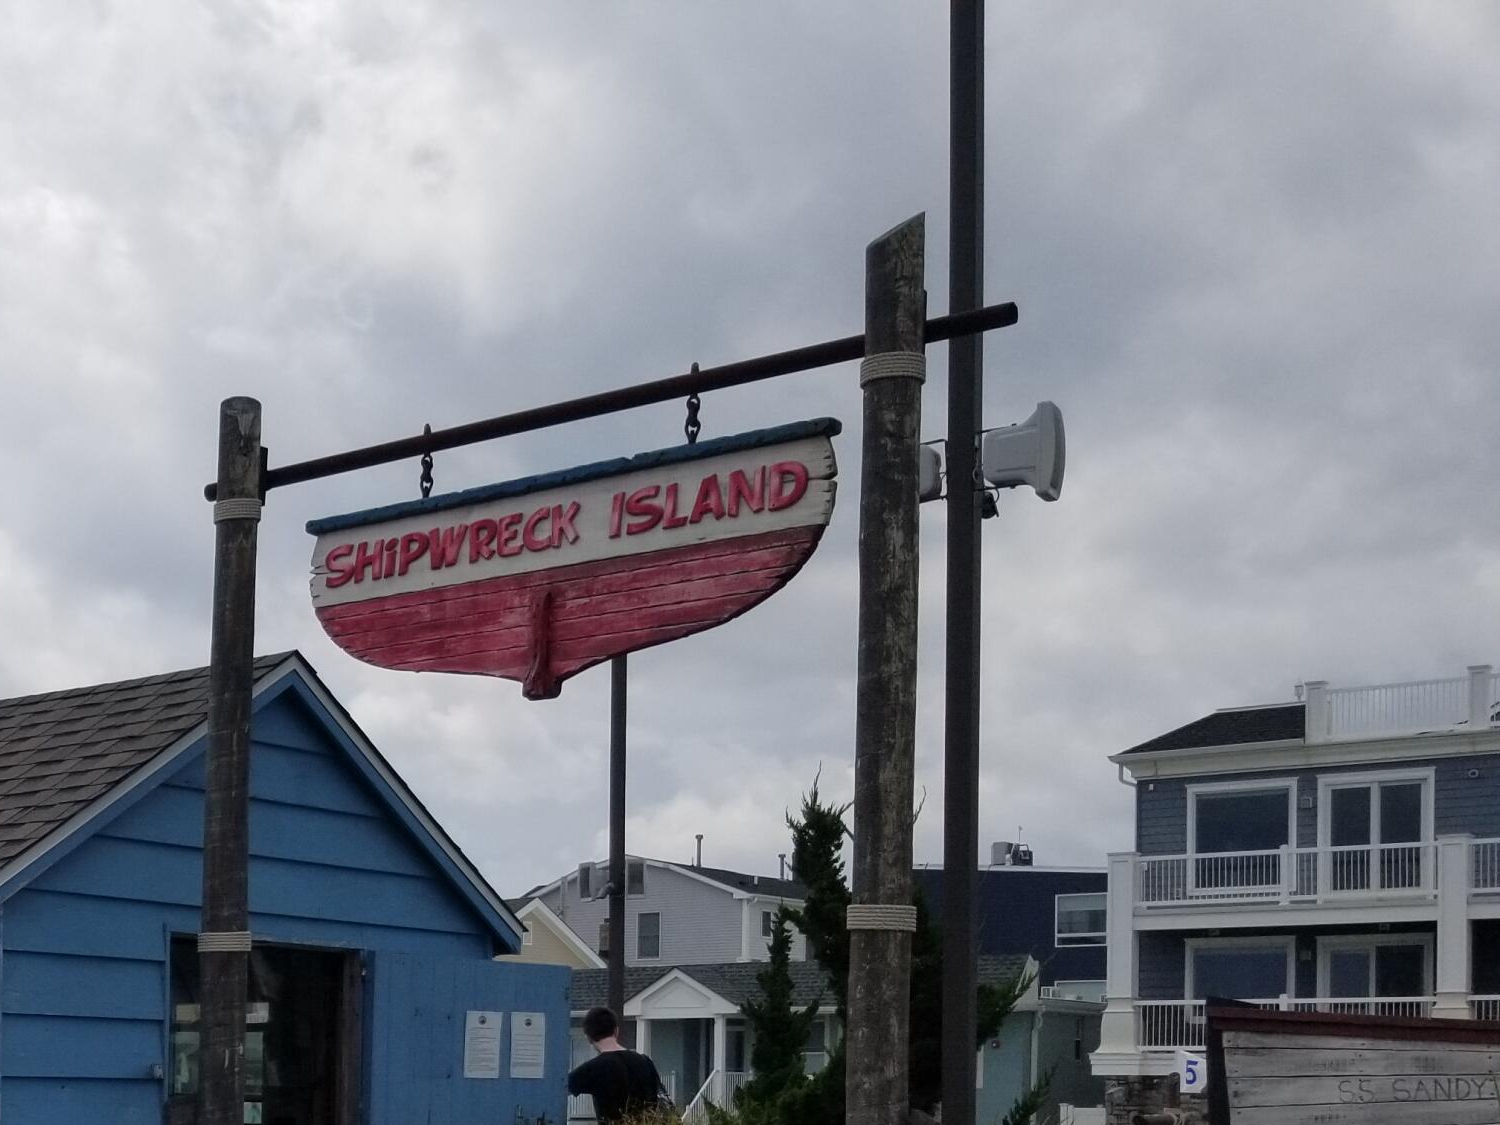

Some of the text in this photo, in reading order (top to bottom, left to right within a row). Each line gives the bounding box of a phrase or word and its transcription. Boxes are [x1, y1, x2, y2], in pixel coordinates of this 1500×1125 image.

[608, 460, 809, 539] ISLAND
[1185, 1059, 1199, 1085] 5
[1392, 1077, 1489, 1101] SANDY
